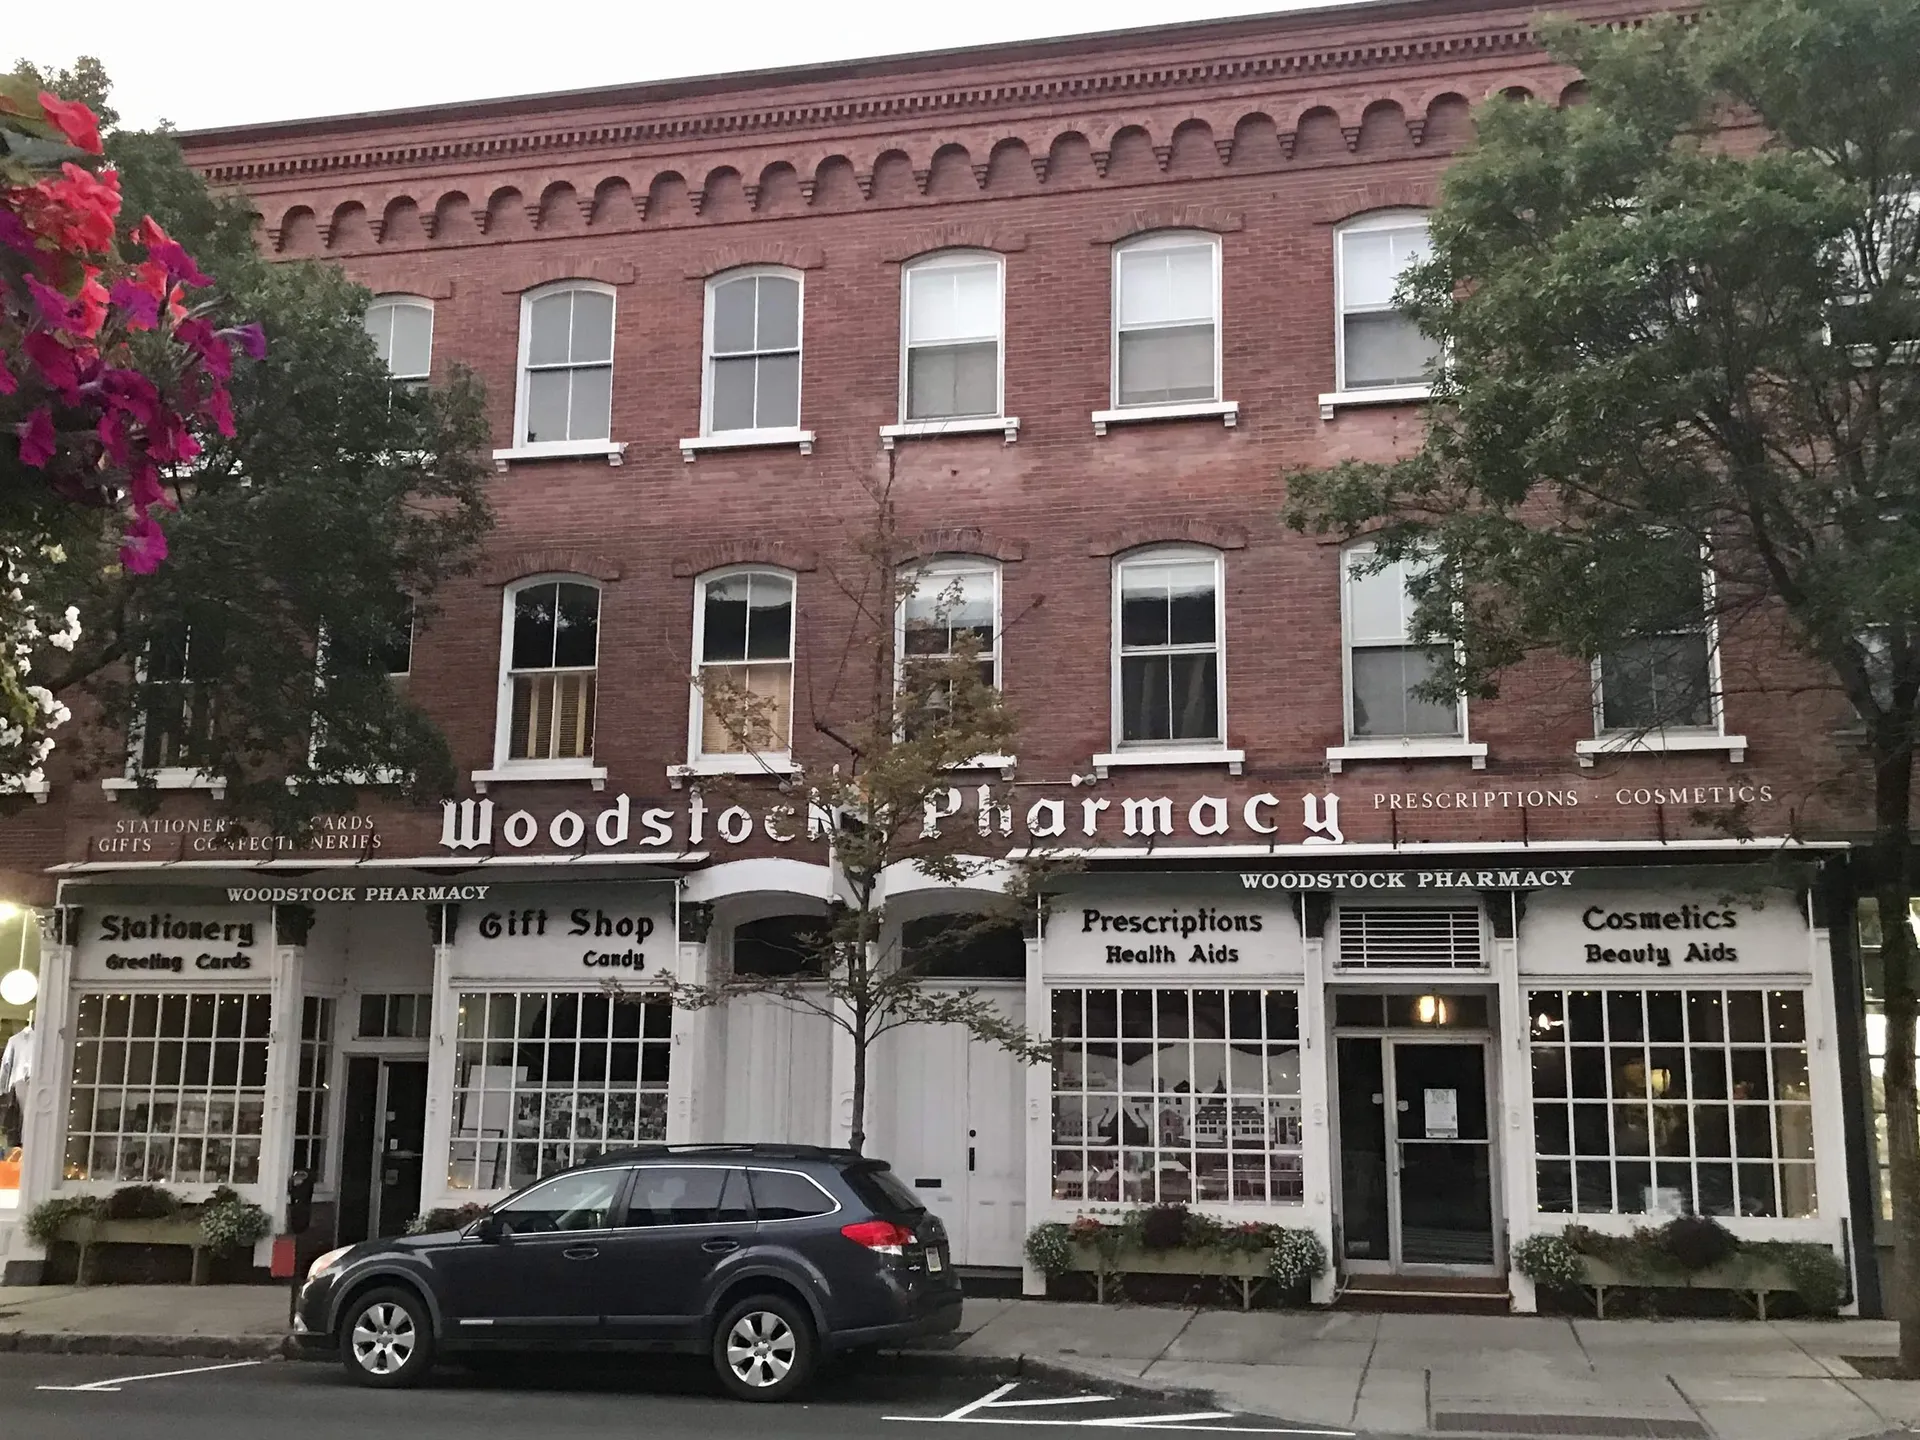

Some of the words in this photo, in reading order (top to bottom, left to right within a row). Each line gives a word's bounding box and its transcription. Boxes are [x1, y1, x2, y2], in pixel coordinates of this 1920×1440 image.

[1373, 790, 1579, 810] PRESCRIPTIONS
[1615, 785, 1774, 805] COSMETICS
[918, 783, 1345, 845] Pharmacy
[116, 819, 238, 833] STATIONER
[98, 838, 152, 852] GIFTS
[1239, 872, 1405, 889] WOODSTOCK
[1417, 870, 1575, 888] PHARMACY
[226, 886, 357, 902] WOODSTOCK
[365, 885, 490, 901] PHARMACY
[479, 909, 548, 939] Gift
[567, 908, 654, 944] Shop
[1081, 907, 1263, 938] Prescriptions
[1582, 905, 1738, 930] Cosmetics
[99, 914, 254, 947] Stationery
[105, 953, 184, 973] Greeting
[195, 952, 252, 971] Cards
[582, 949, 645, 970] Candy
[1105, 944, 1175, 963] Health
[1188, 943, 1239, 963] Aids
[1584, 943, 1671, 966] Beauty
[1684, 942, 1738, 962] Aids
